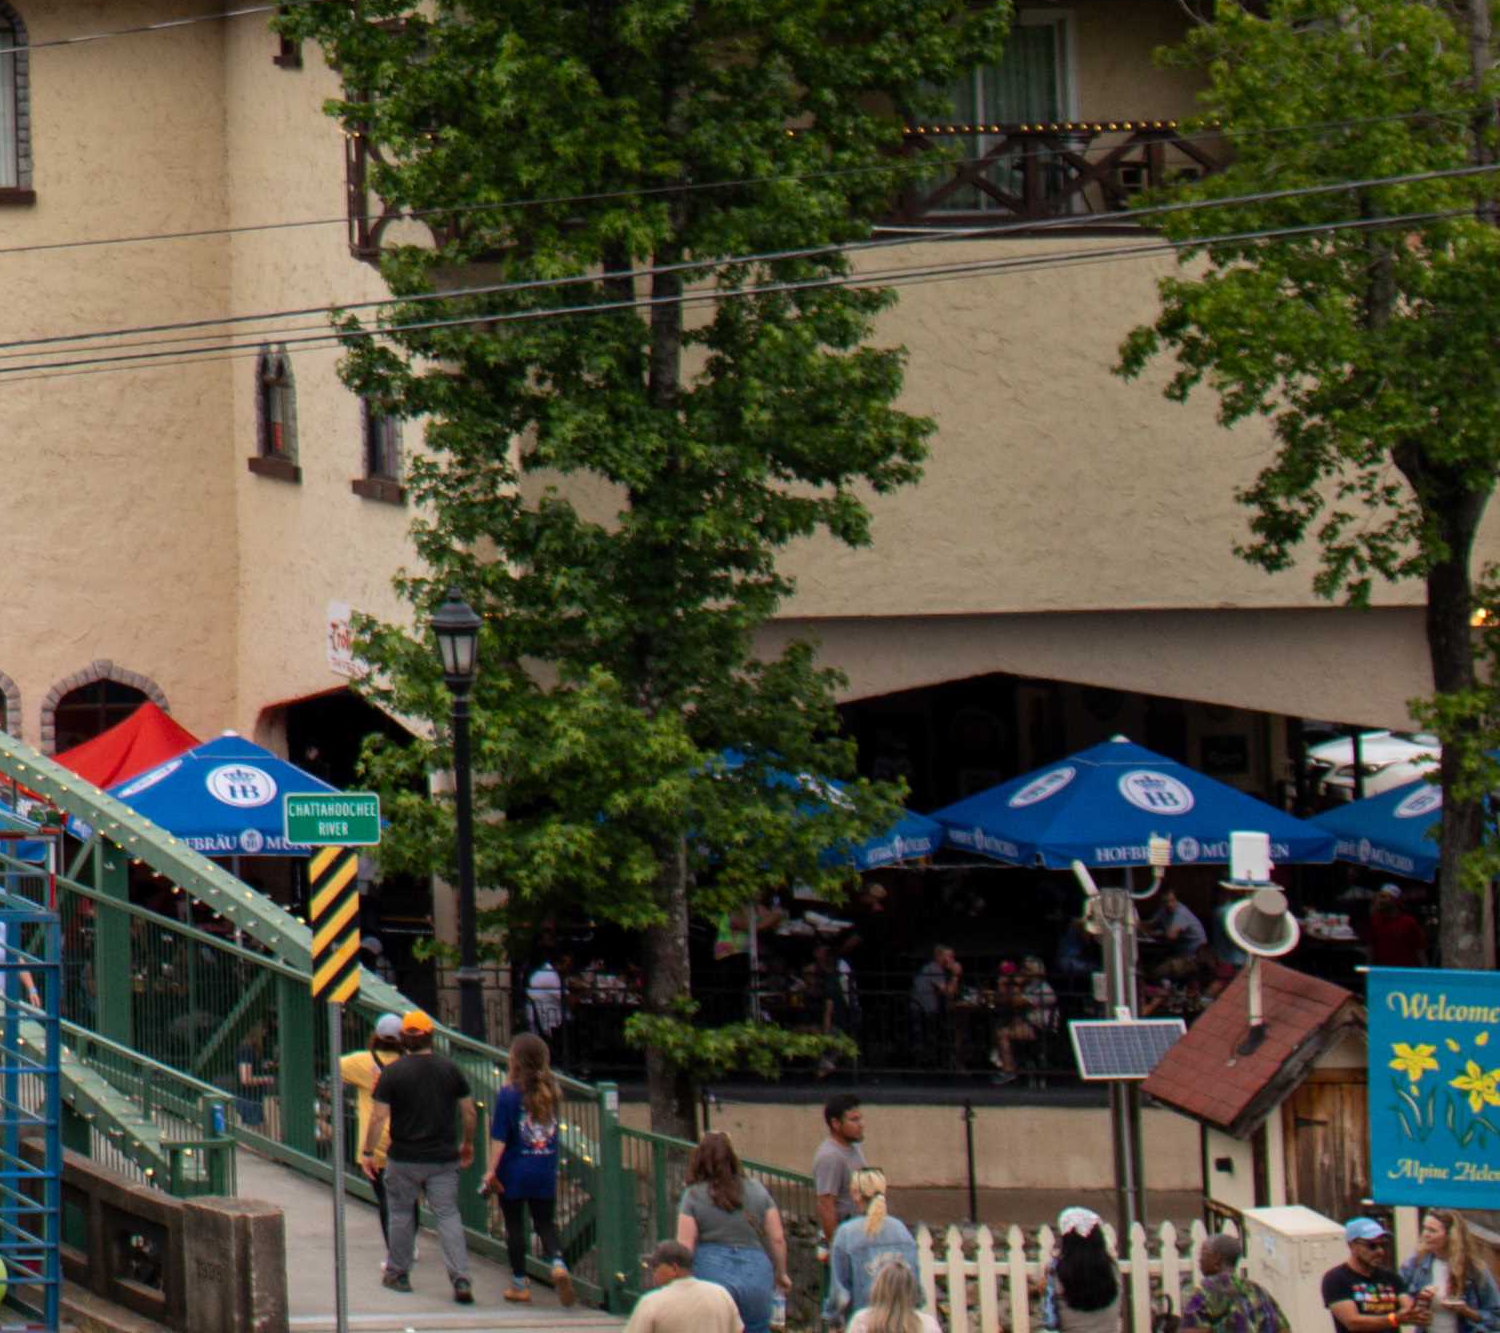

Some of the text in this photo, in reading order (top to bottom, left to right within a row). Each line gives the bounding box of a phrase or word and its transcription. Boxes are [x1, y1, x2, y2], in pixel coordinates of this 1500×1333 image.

[227, 784, 261, 801] HB
[1146, 788, 1179, 808] HB
[288, 802, 376, 818] CHATTAHOOCHEE
[318, 821, 349, 838] RIVER
[1096, 840, 1290, 863] HOFBR MÜEN
[1387, 990, 1500, 1025] Welcome
[1387, 1157, 1449, 1185] Alpine
